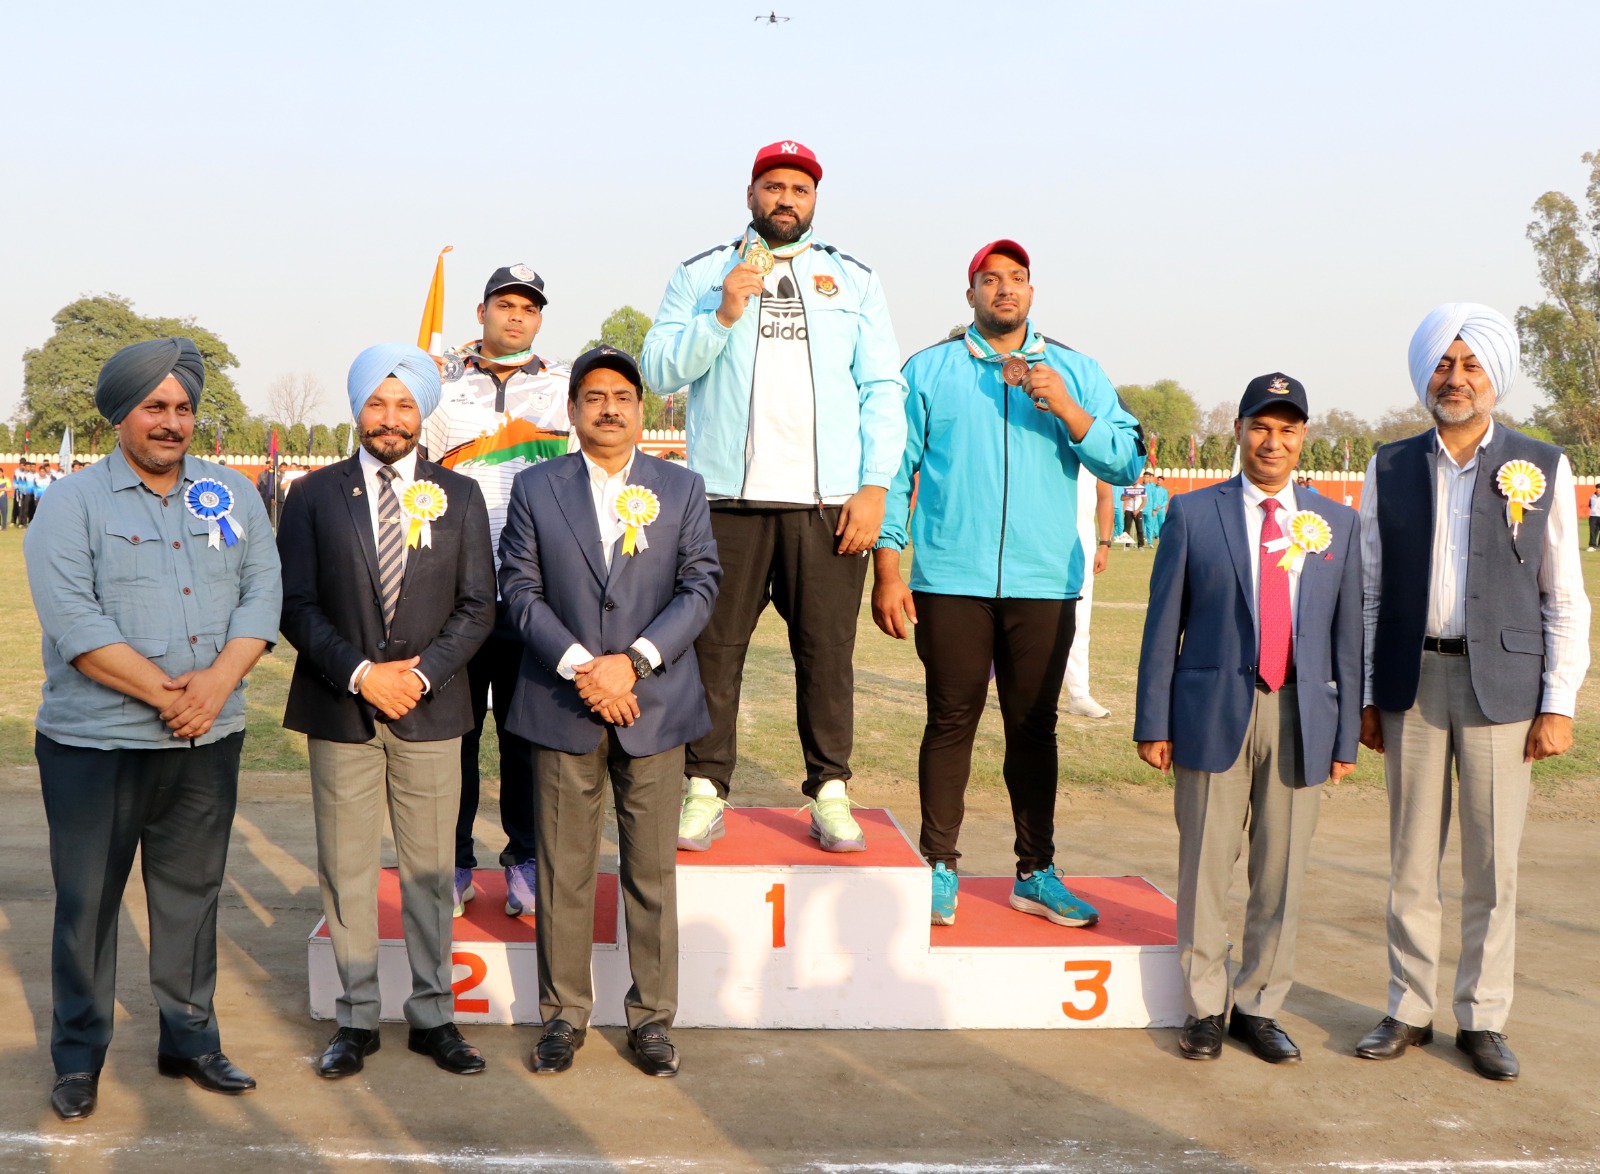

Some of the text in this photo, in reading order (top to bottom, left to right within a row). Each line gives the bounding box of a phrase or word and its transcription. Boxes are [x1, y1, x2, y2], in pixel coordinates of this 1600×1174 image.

[761, 321, 807, 340] dida
[765, 884, 786, 948] 1
[452, 952, 489, 1013] 2
[1062, 960, 1112, 1020] 3
